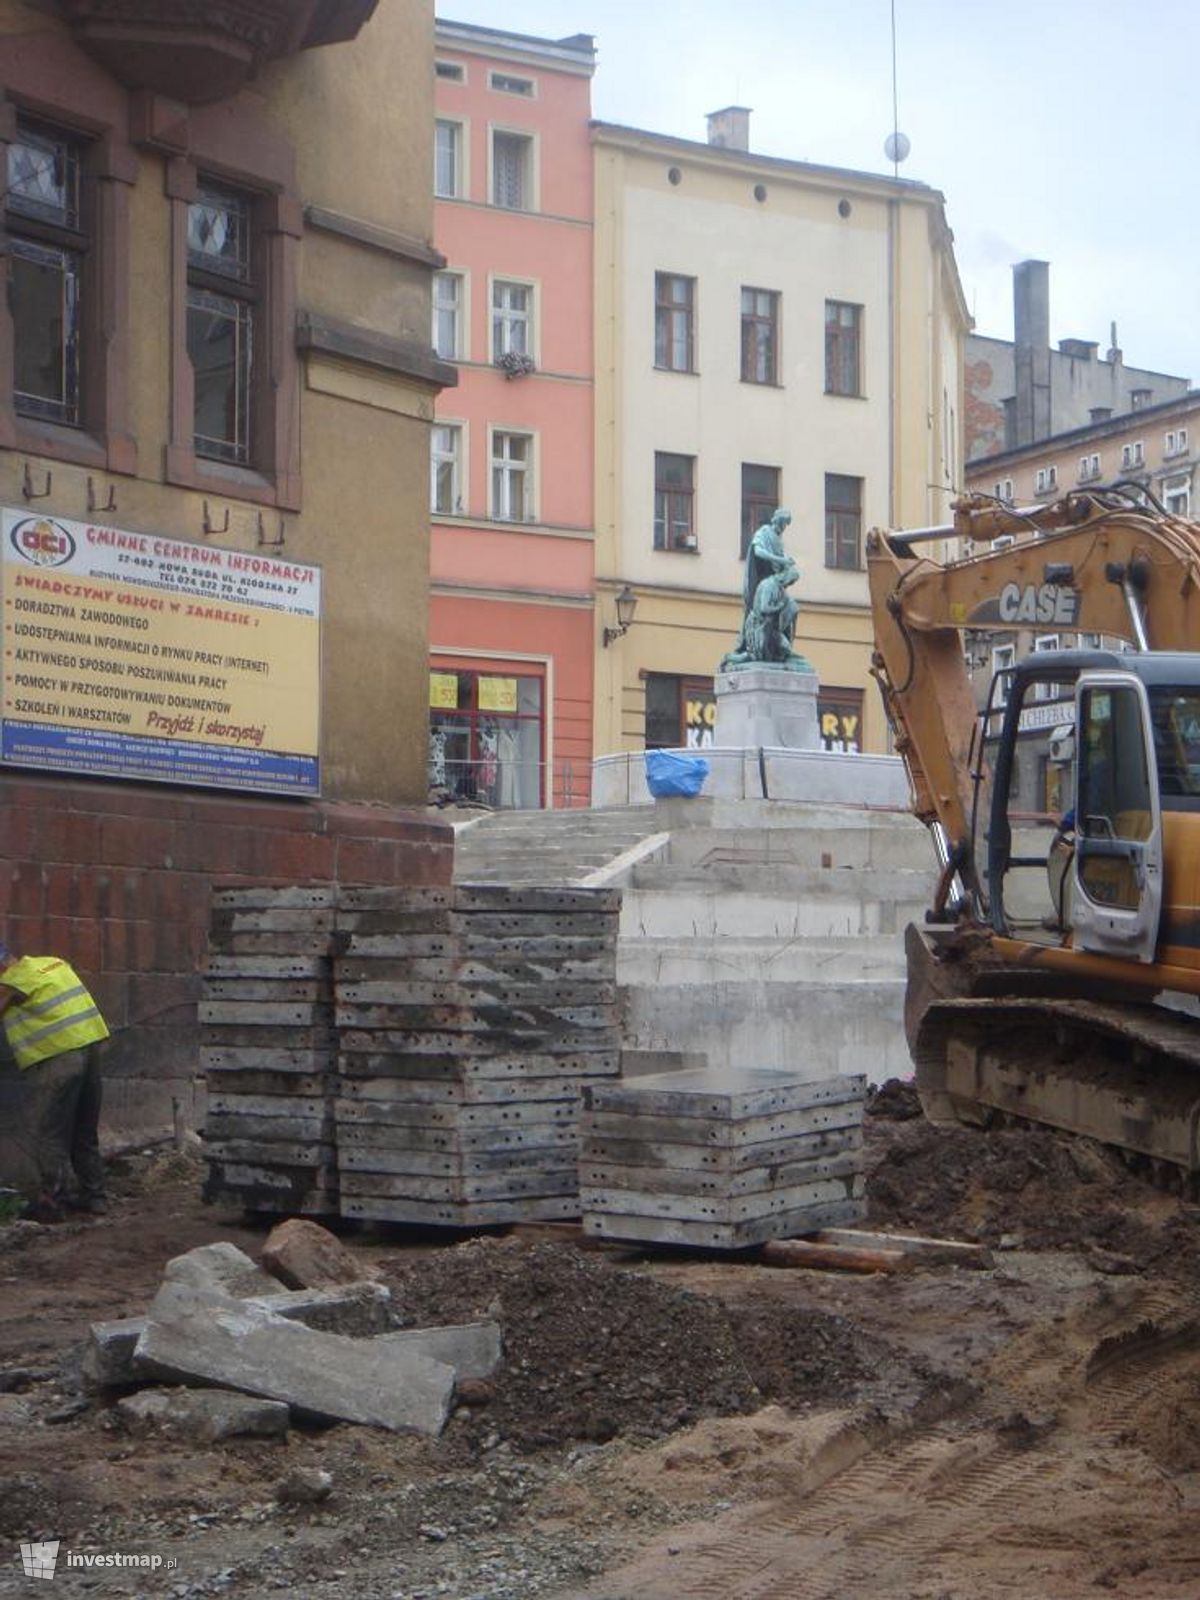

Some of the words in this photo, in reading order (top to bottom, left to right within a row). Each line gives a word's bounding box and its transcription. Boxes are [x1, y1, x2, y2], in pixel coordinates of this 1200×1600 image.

[86, 528, 147, 552] GMINNE
[154, 542, 221, 566] CENTRUM
[228, 554, 314, 583] INFORMACJI
[14, 598, 77, 619] DORADZTWA
[80, 608, 150, 630] ZAWODOWEGO
[185, 604, 250, 626] ZAKRESIE
[999, 582, 1075, 624] CASE
[94, 636, 150, 655] INFORMACJI
[151, 645, 160, 656] O
[161, 646, 193, 661] RYNKU
[194, 651, 224, 667] PRACY
[15, 648, 77, 668] AKTYWNEGO
[79, 656, 126, 675] SPOSOBU
[127, 665, 196, 685] POSZUKIWANIA
[198, 676, 228, 690] PRACY
[14, 673, 59, 690] POMOCY
[60, 680, 70, 692] W
[70, 680, 165, 706] PRZYGOTOWYWANIU
[205, 720, 267, 747] skorzystaj
